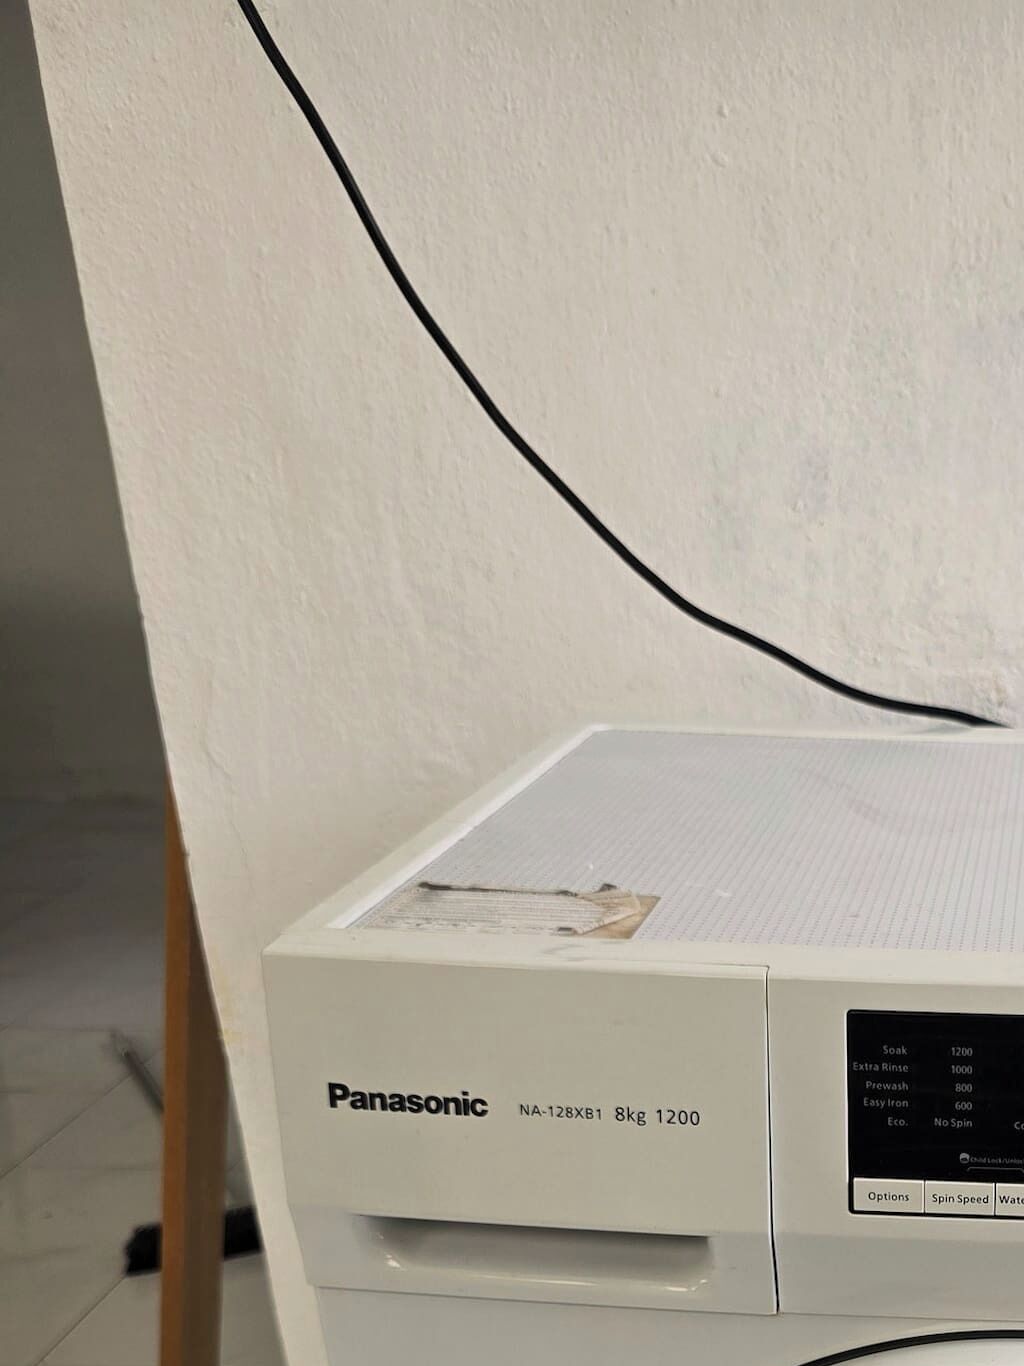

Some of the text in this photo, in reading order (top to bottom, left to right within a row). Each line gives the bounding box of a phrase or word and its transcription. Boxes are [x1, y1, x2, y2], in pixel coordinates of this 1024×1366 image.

[882, 1045, 908, 1055] Soak
[951, 1047, 973, 1057] 1200
[852, 1062, 909, 1073] Extra Rinse
[951, 1065, 973, 1074] 1000
[865, 1081, 909, 1091] Prewash
[955, 1083, 973, 1092] 800
[327, 1082, 489, 1117] Panasonic
[863, 1097, 909, 1109] Easy Iron
[955, 1101, 973, 1111] 600
[519, 1103, 701, 1126] NA-128XB1 8kg 1200
[887, 1117, 909, 1126] Eco.
[934, 1118, 973, 1129] No Spin
[970, 1156, 986, 1164] Child
[868, 1191, 910, 1203] Options
[932, 1193, 989, 1205] Spin Speed
